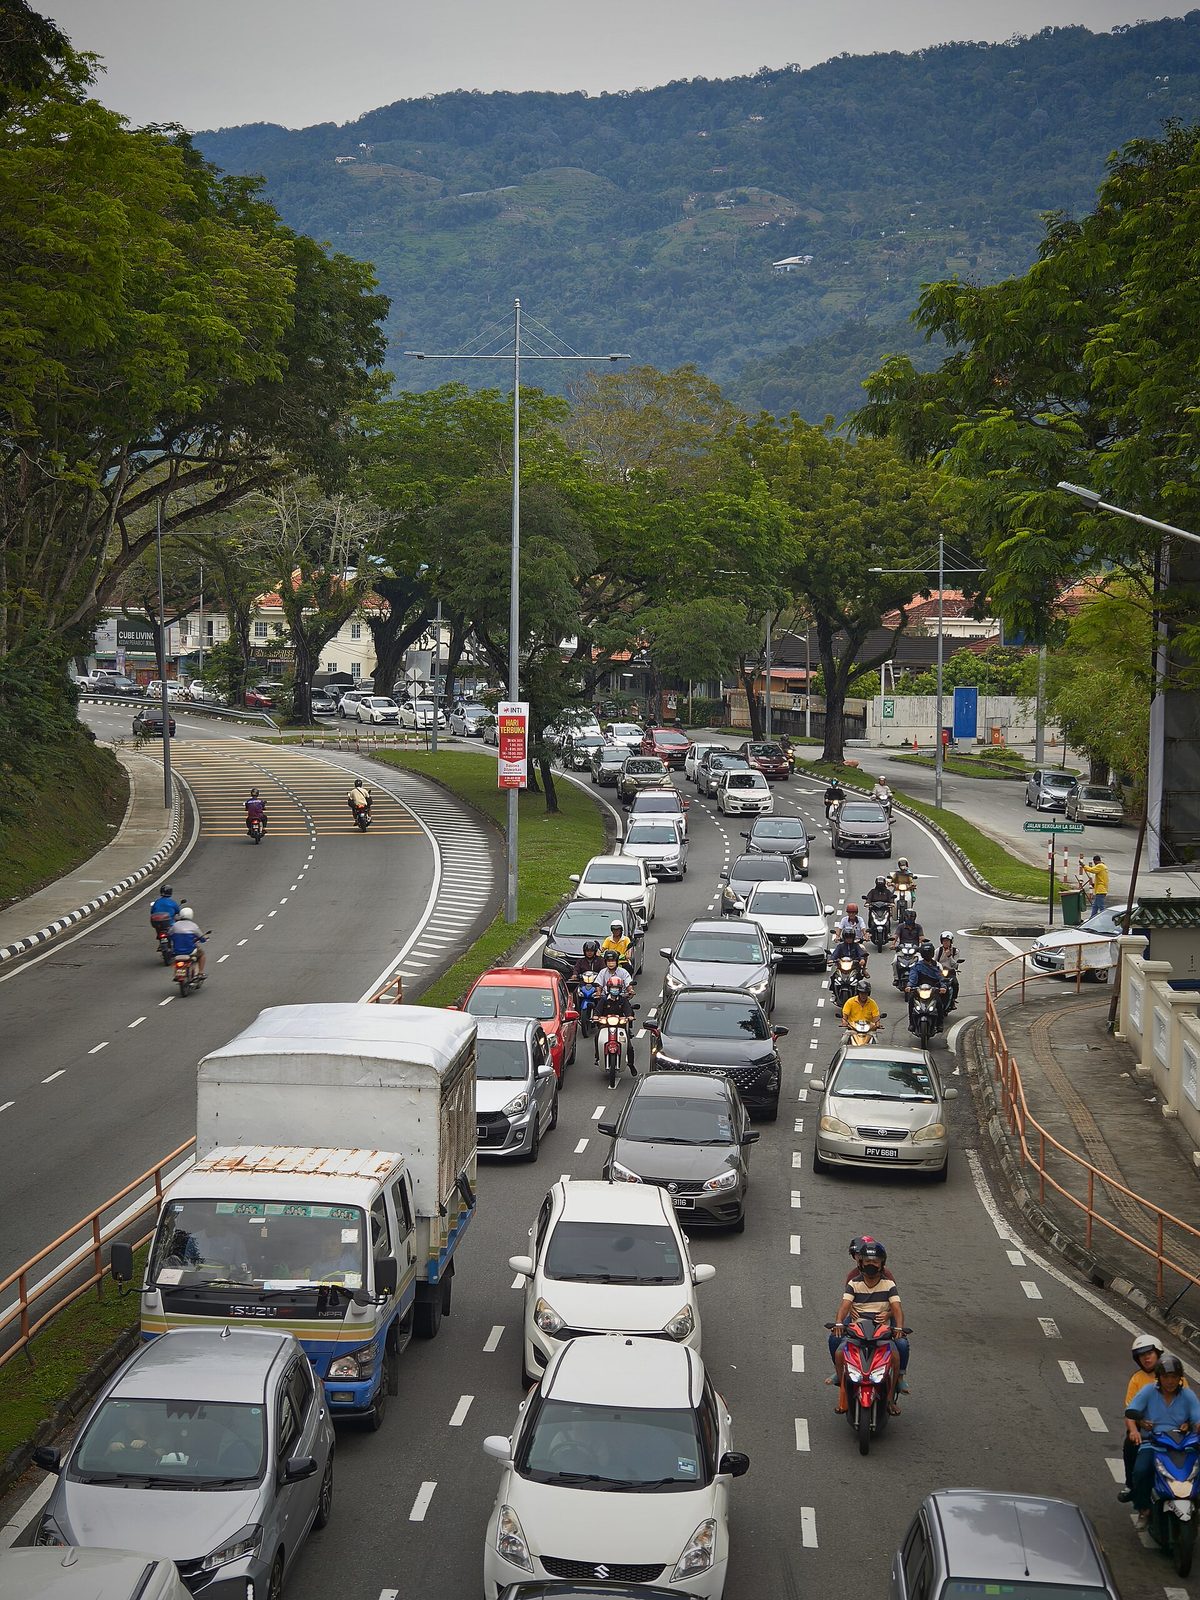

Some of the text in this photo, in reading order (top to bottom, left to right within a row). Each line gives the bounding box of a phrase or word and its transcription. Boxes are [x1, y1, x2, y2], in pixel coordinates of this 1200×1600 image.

[118, 631, 135, 640] CUBE
[505, 719, 519, 727] HARI
[500, 726, 525, 734] TERBUKA
[866, 1148, 880, 1156] PFV
[673, 1198, 687, 1206] 3116
[230, 1305, 277, 1317] ISUZU
